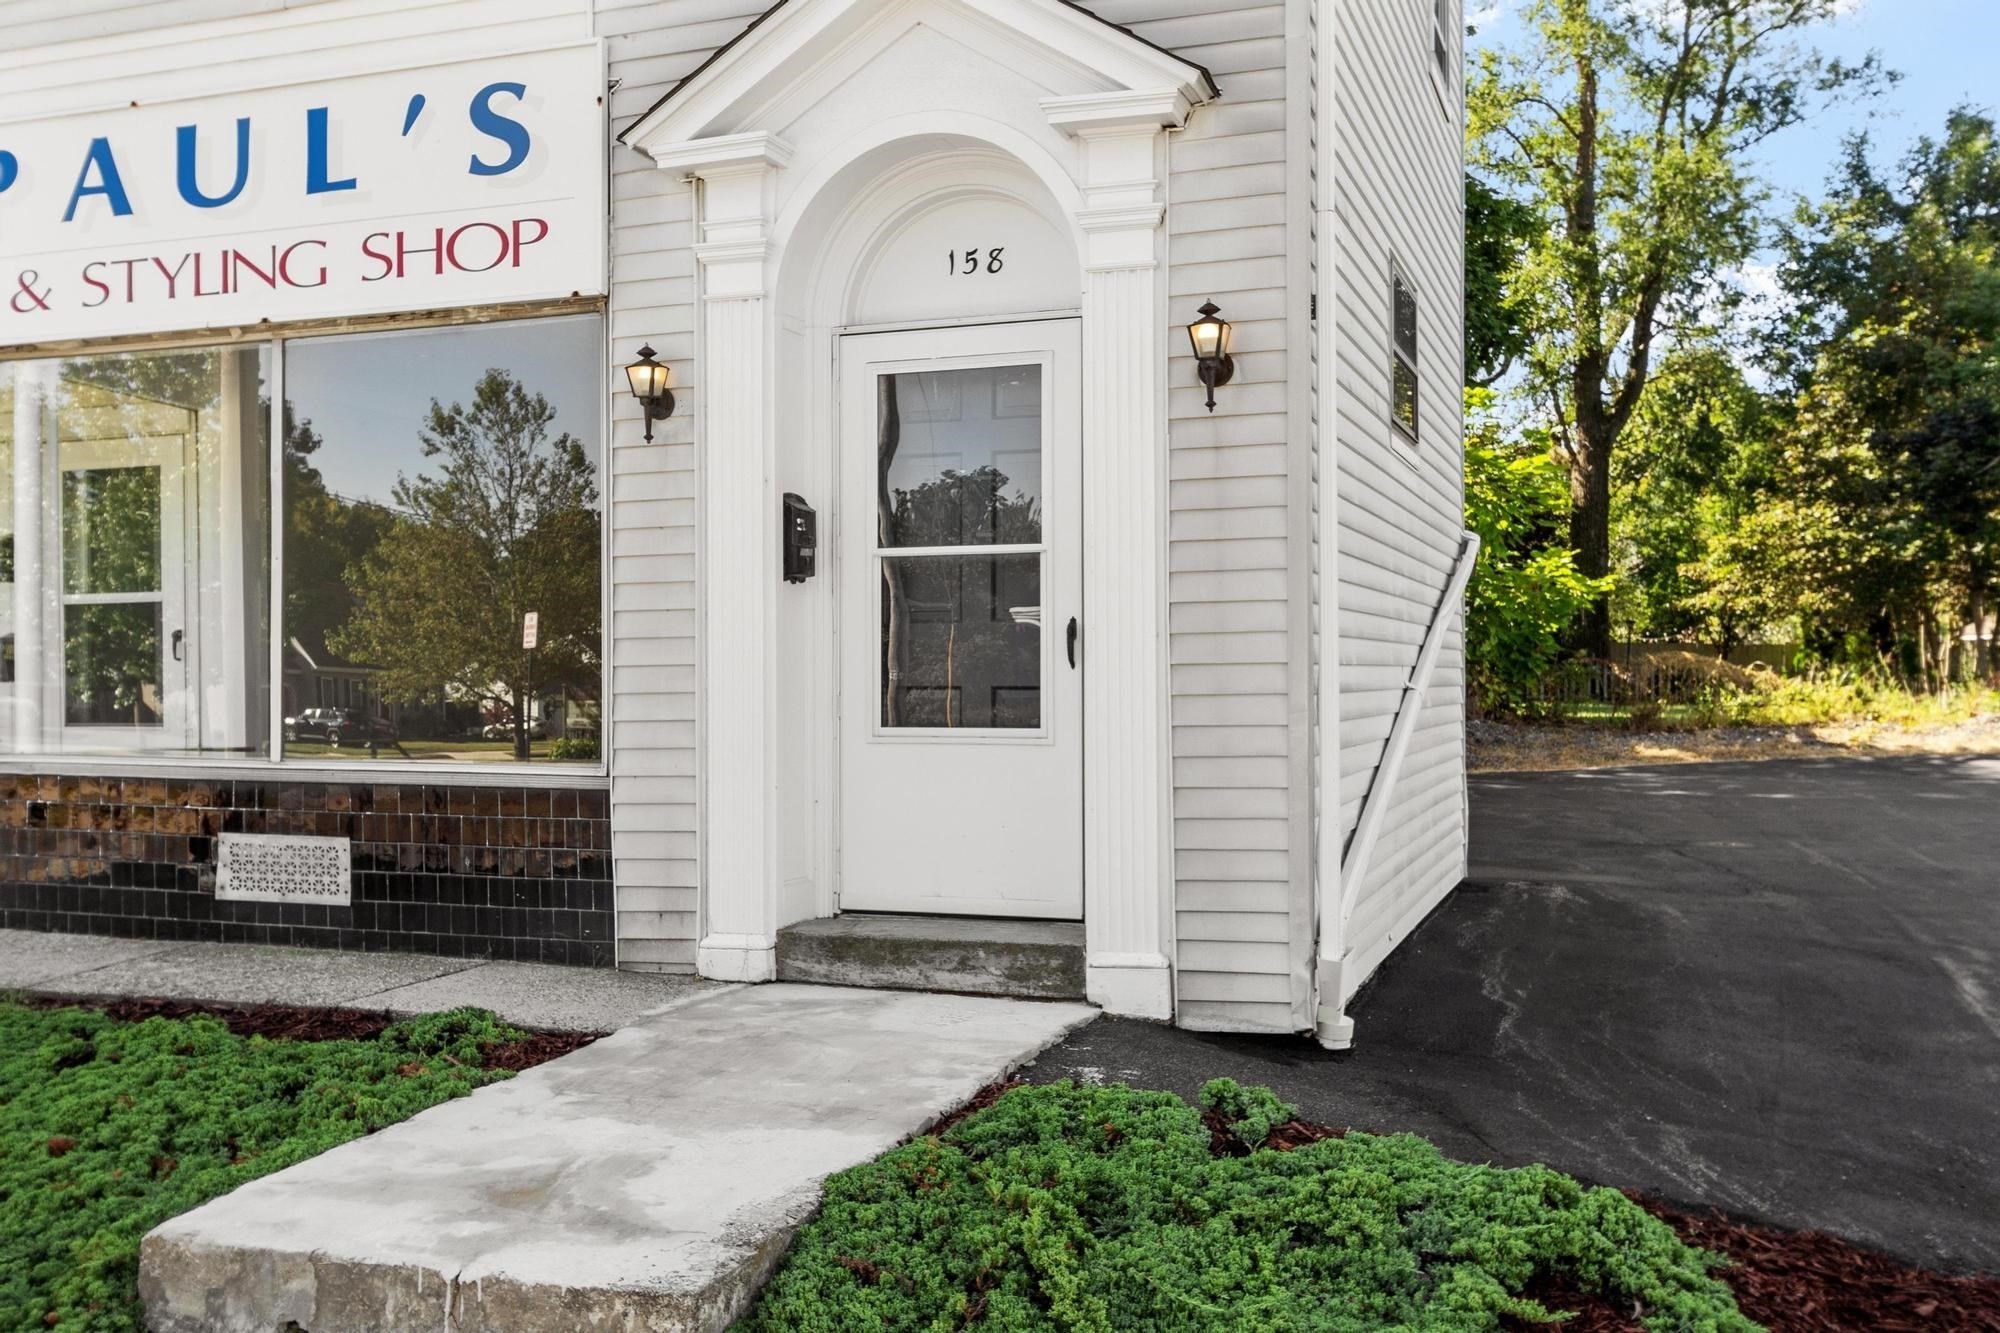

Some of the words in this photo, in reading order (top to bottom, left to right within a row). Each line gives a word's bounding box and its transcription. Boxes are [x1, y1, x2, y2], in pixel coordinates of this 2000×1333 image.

[10, 269, 52, 313] &
[82, 241, 328, 308] STYLING
[361, 217, 549, 282] SHOP
[948, 247, 1005, 276] 158
